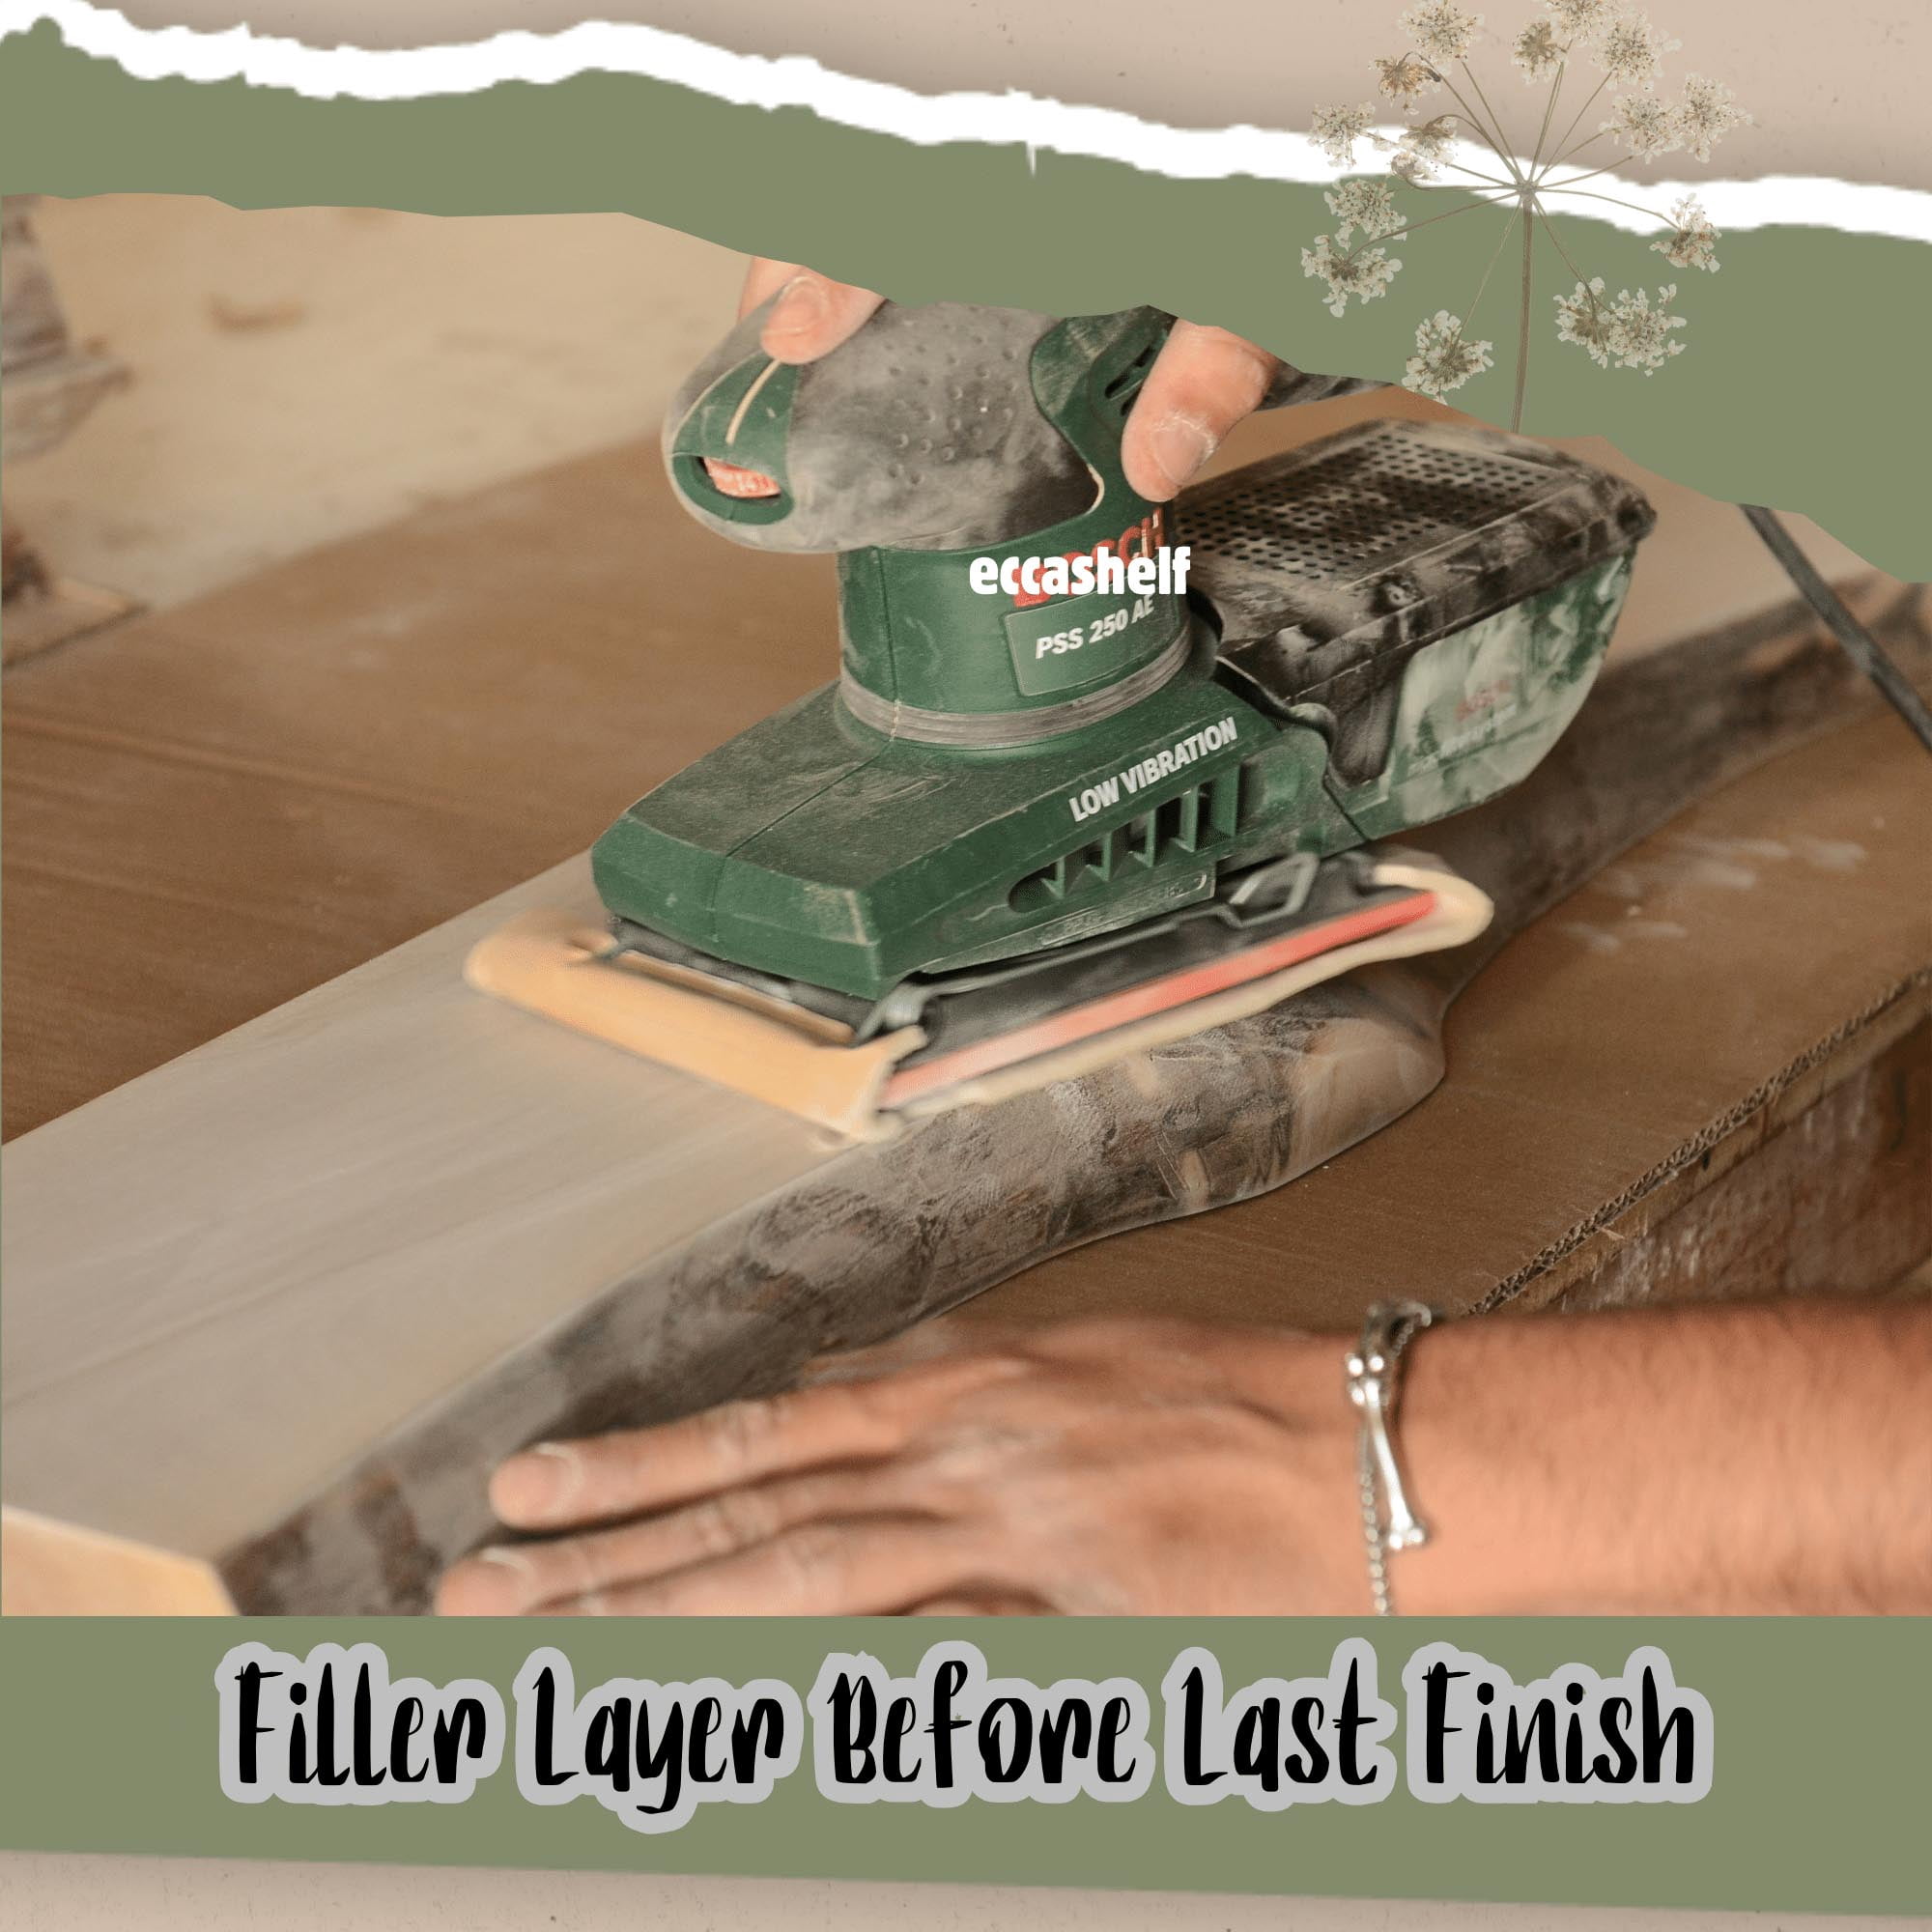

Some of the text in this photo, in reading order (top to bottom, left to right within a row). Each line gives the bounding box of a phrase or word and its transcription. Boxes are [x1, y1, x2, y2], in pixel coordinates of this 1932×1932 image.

[1035, 593, 1155, 660] PSS 250 AE
[1068, 716, 1238, 822] LOW VIBRATION
